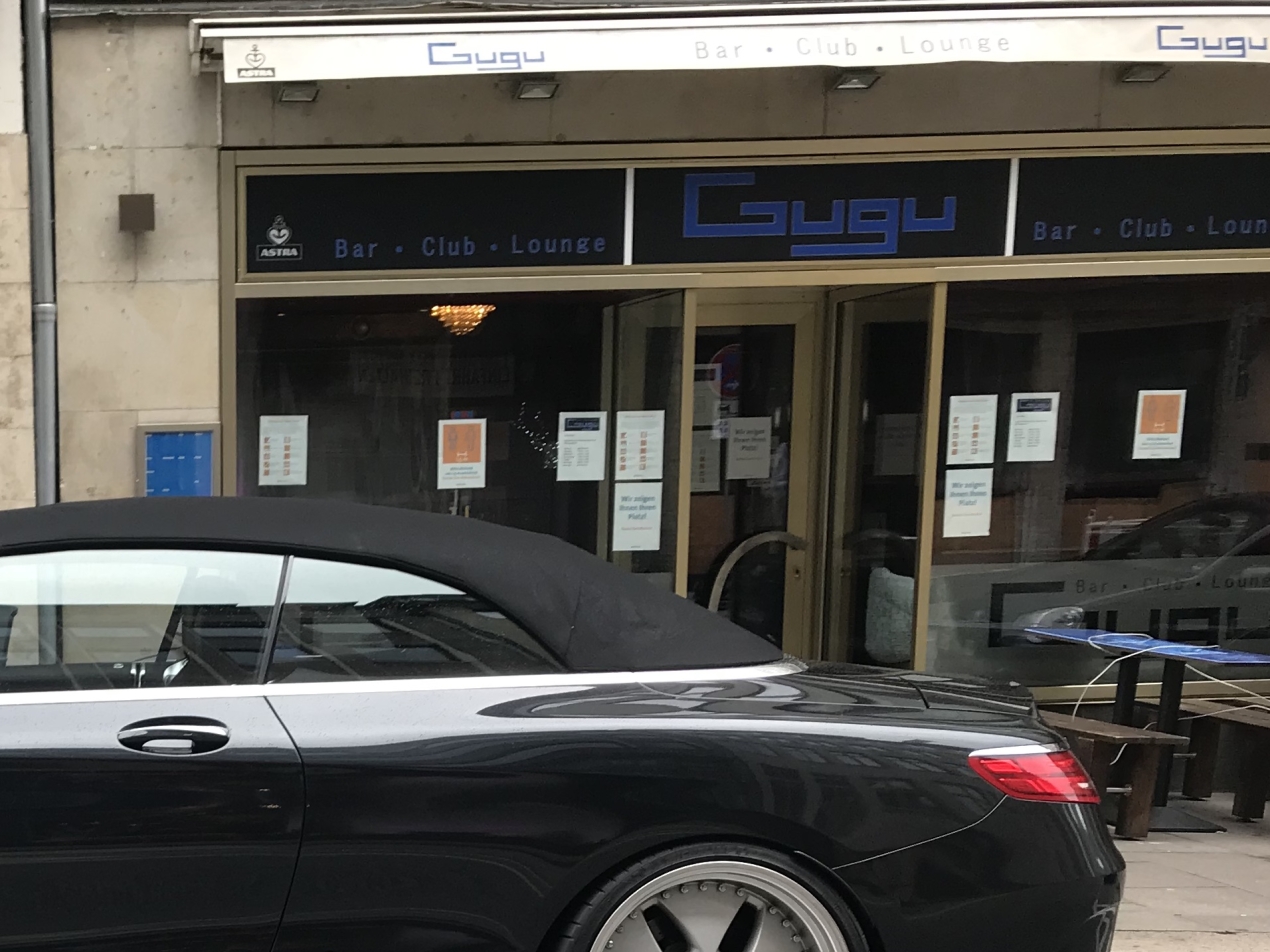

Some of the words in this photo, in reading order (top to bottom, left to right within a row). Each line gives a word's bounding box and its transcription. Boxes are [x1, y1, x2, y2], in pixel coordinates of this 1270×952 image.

[694, 41, 743, 59] Bar
[796, 37, 858, 56] Club
[899, 35, 1010, 54] Lounge
[1156, 25, 1267, 58] Gugu
[427, 42, 545, 71] Gugu
[238, 68, 276, 78] ASTRA
[683, 172, 957, 256] Gugu
[1032, 221, 1077, 241] Bar
[1119, 217, 1173, 238] Club
[259, 247, 299, 258] ASTRA
[334, 238, 378, 259] Bar
[422, 236, 476, 257] Club
[511, 234, 606, 255] Lounge
[1076, 579, 1109, 594] Bar
